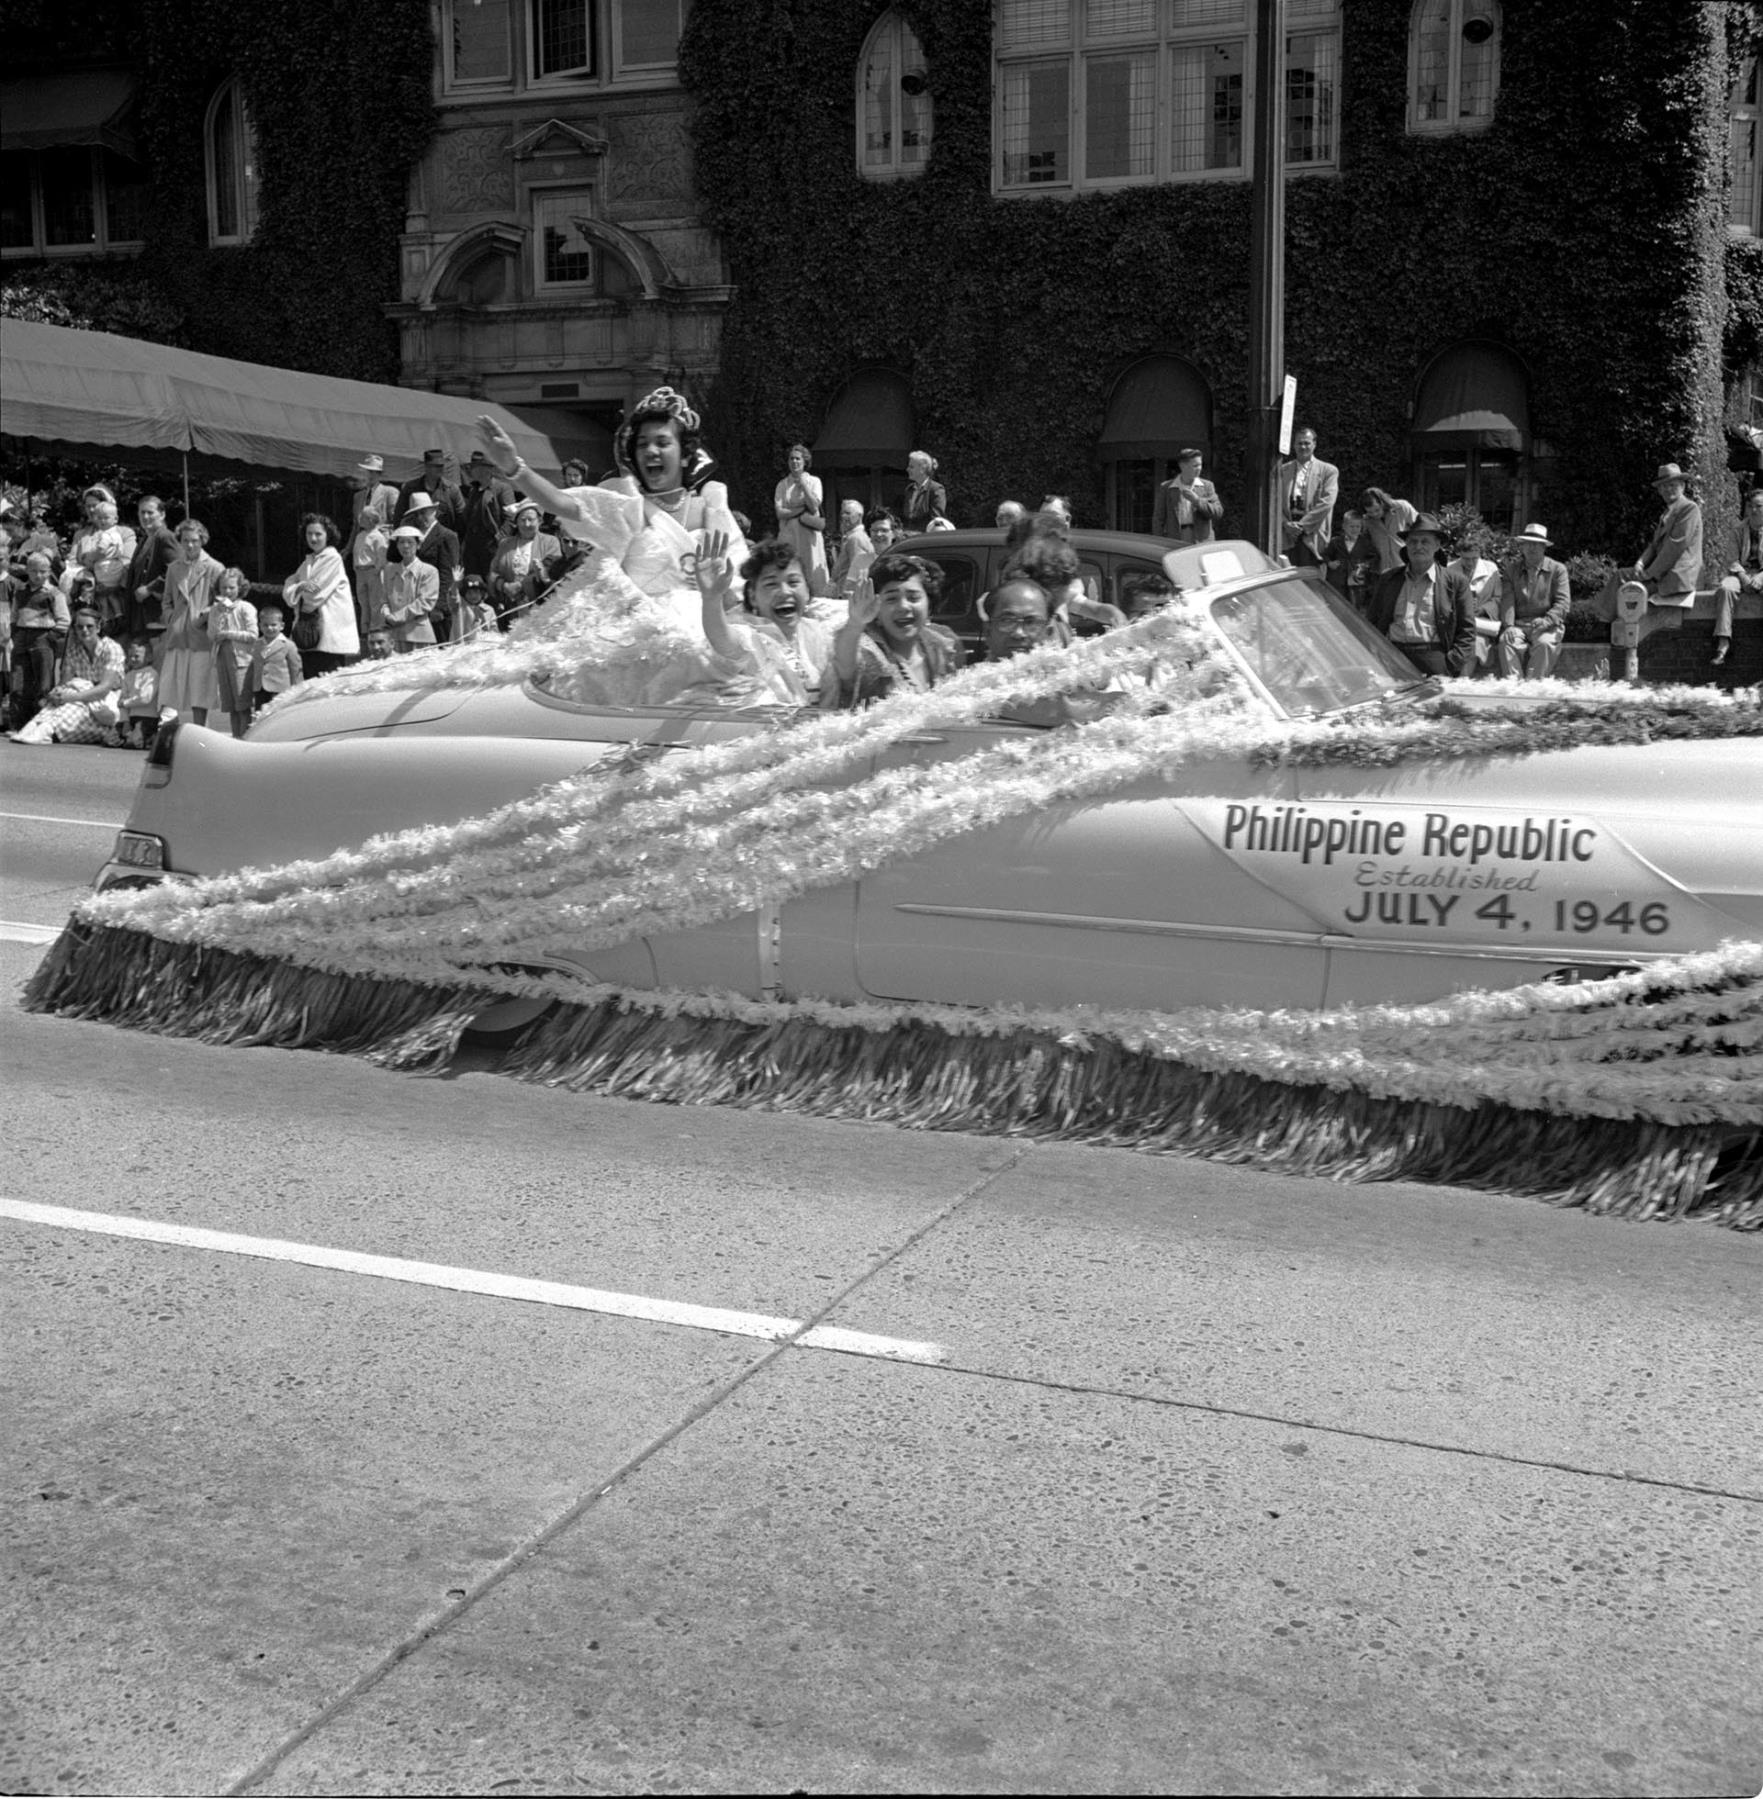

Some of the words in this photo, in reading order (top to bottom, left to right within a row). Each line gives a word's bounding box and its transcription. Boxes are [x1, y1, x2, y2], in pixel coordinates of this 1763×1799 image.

[1225, 804, 1405, 864] Philippine
[1422, 814, 1597, 863] Republic
[1356, 861, 1540, 891] Established
[1345, 891, 1460, 926] JULY
[1475, 894, 1531, 932] 4,
[1556, 900, 1669, 935] 1946
